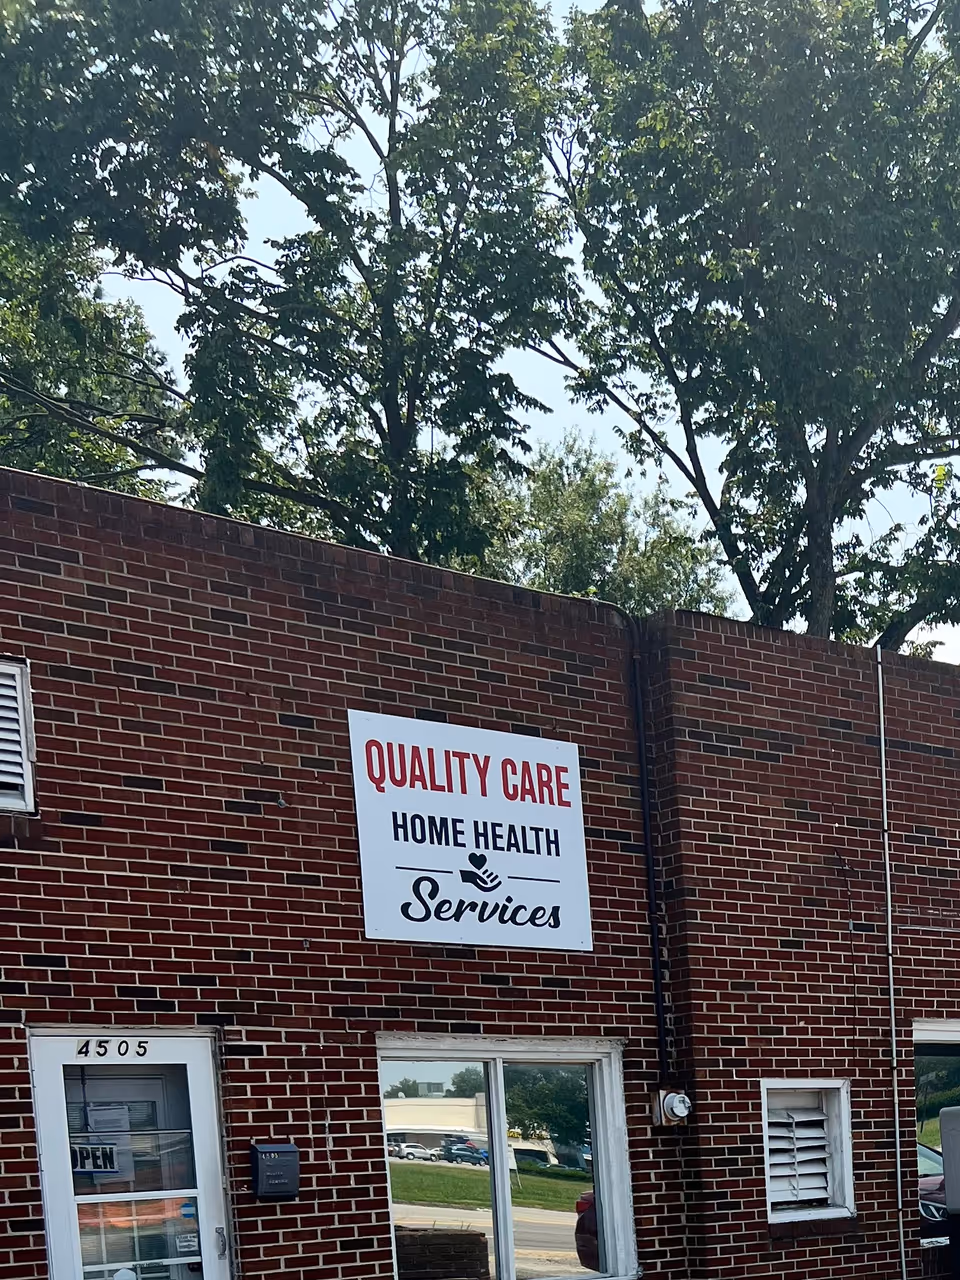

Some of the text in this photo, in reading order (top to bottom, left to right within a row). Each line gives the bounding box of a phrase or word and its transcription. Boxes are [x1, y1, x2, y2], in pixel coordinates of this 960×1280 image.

[365, 739, 572, 808] QUALITY CARE
[391, 811, 561, 857] HOME HEALTH
[400, 876, 561, 929] Services
[77, 1039, 149, 1057] 4505
